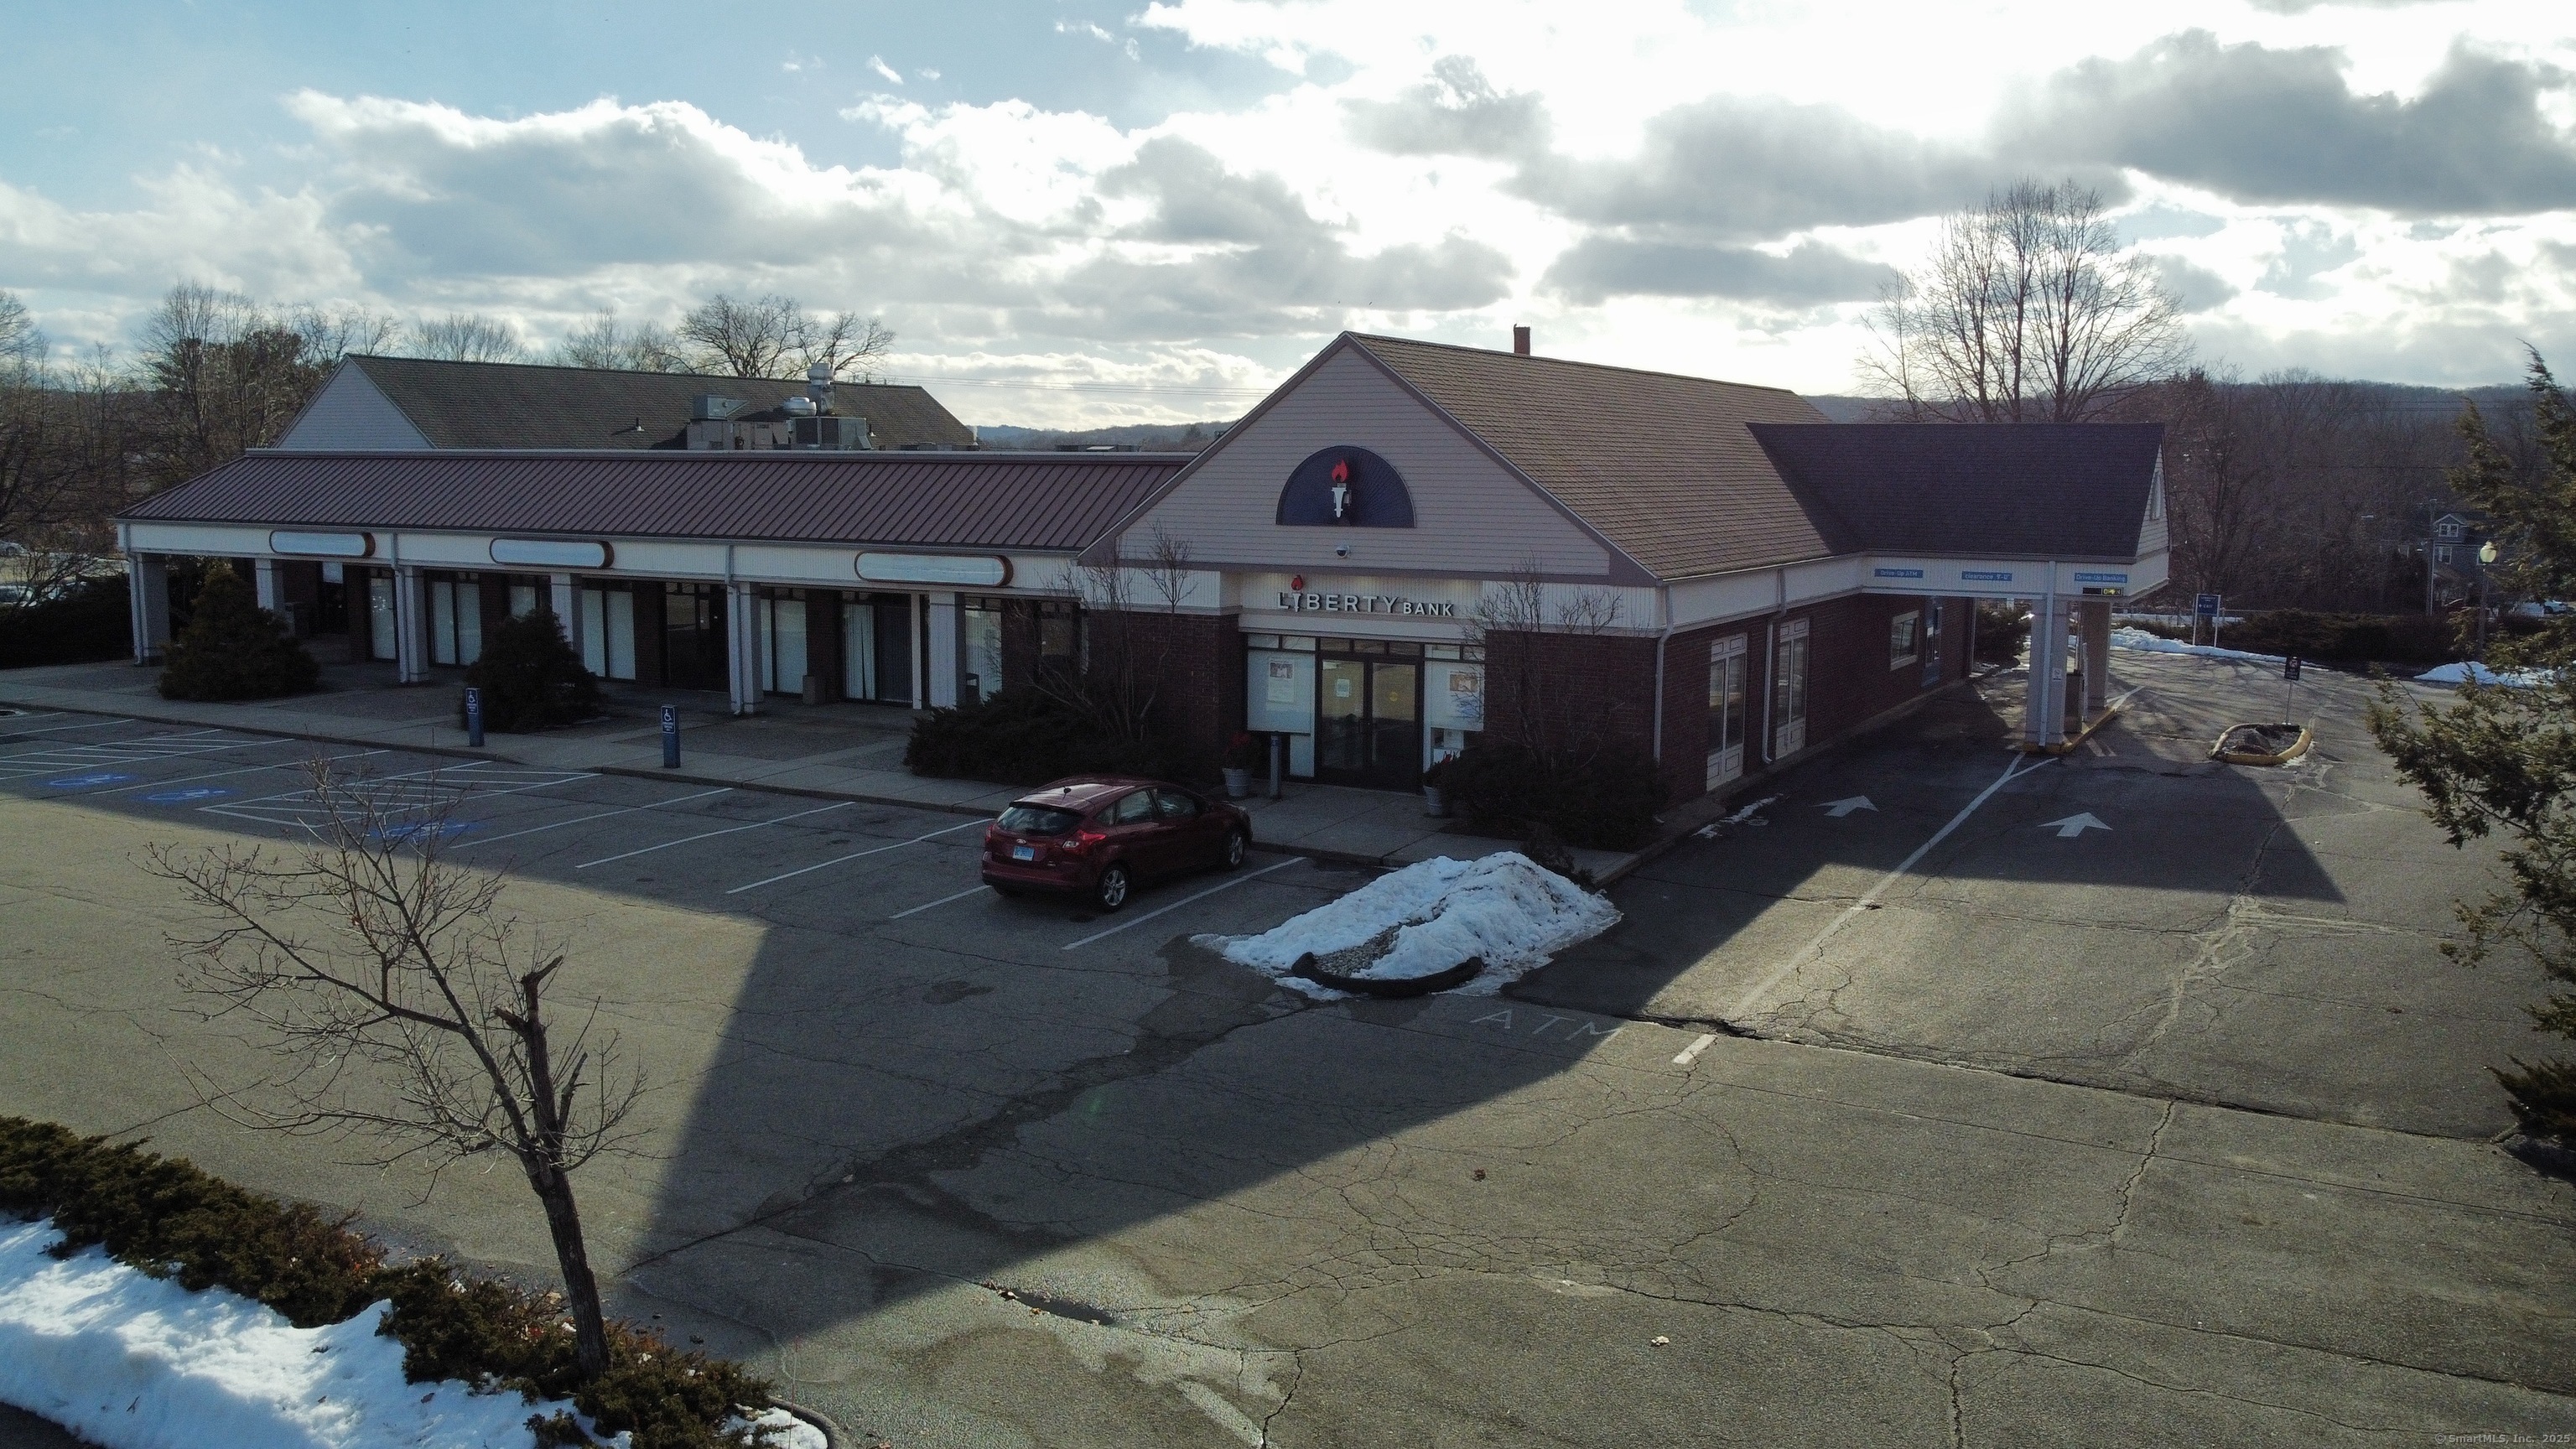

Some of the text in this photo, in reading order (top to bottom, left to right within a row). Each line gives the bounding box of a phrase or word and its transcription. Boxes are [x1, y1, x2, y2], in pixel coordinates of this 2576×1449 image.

[1276, 591, 1455, 616] LIBERTY BANK
[1469, 1009, 1627, 1052] ATM
